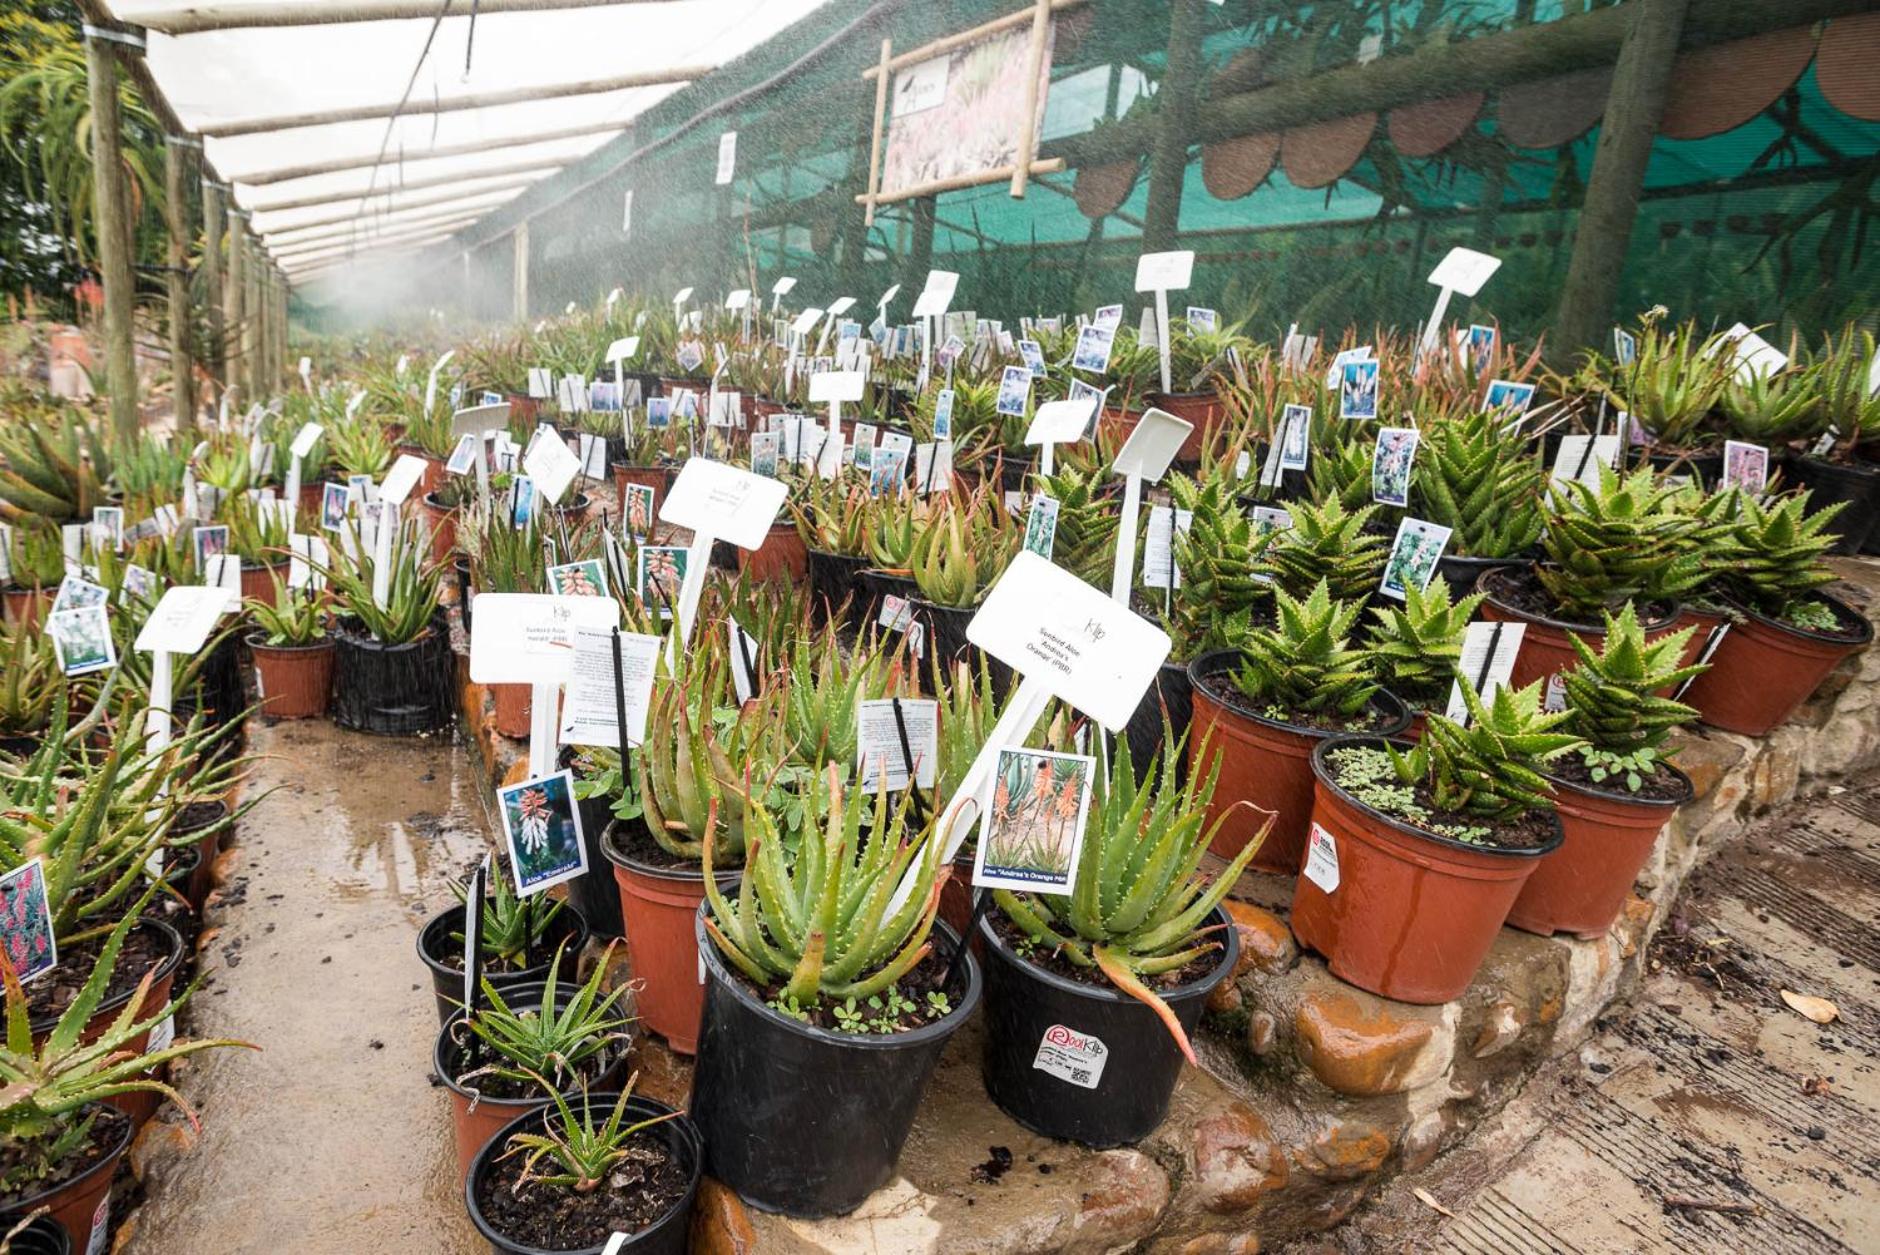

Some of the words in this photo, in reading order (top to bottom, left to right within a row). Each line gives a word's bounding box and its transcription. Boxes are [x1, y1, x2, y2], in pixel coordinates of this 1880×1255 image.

[1065, 643, 1080, 657] Aloe
[526, 874, 543, 885] Aloe
[1030, 872, 1054, 882] Orange
